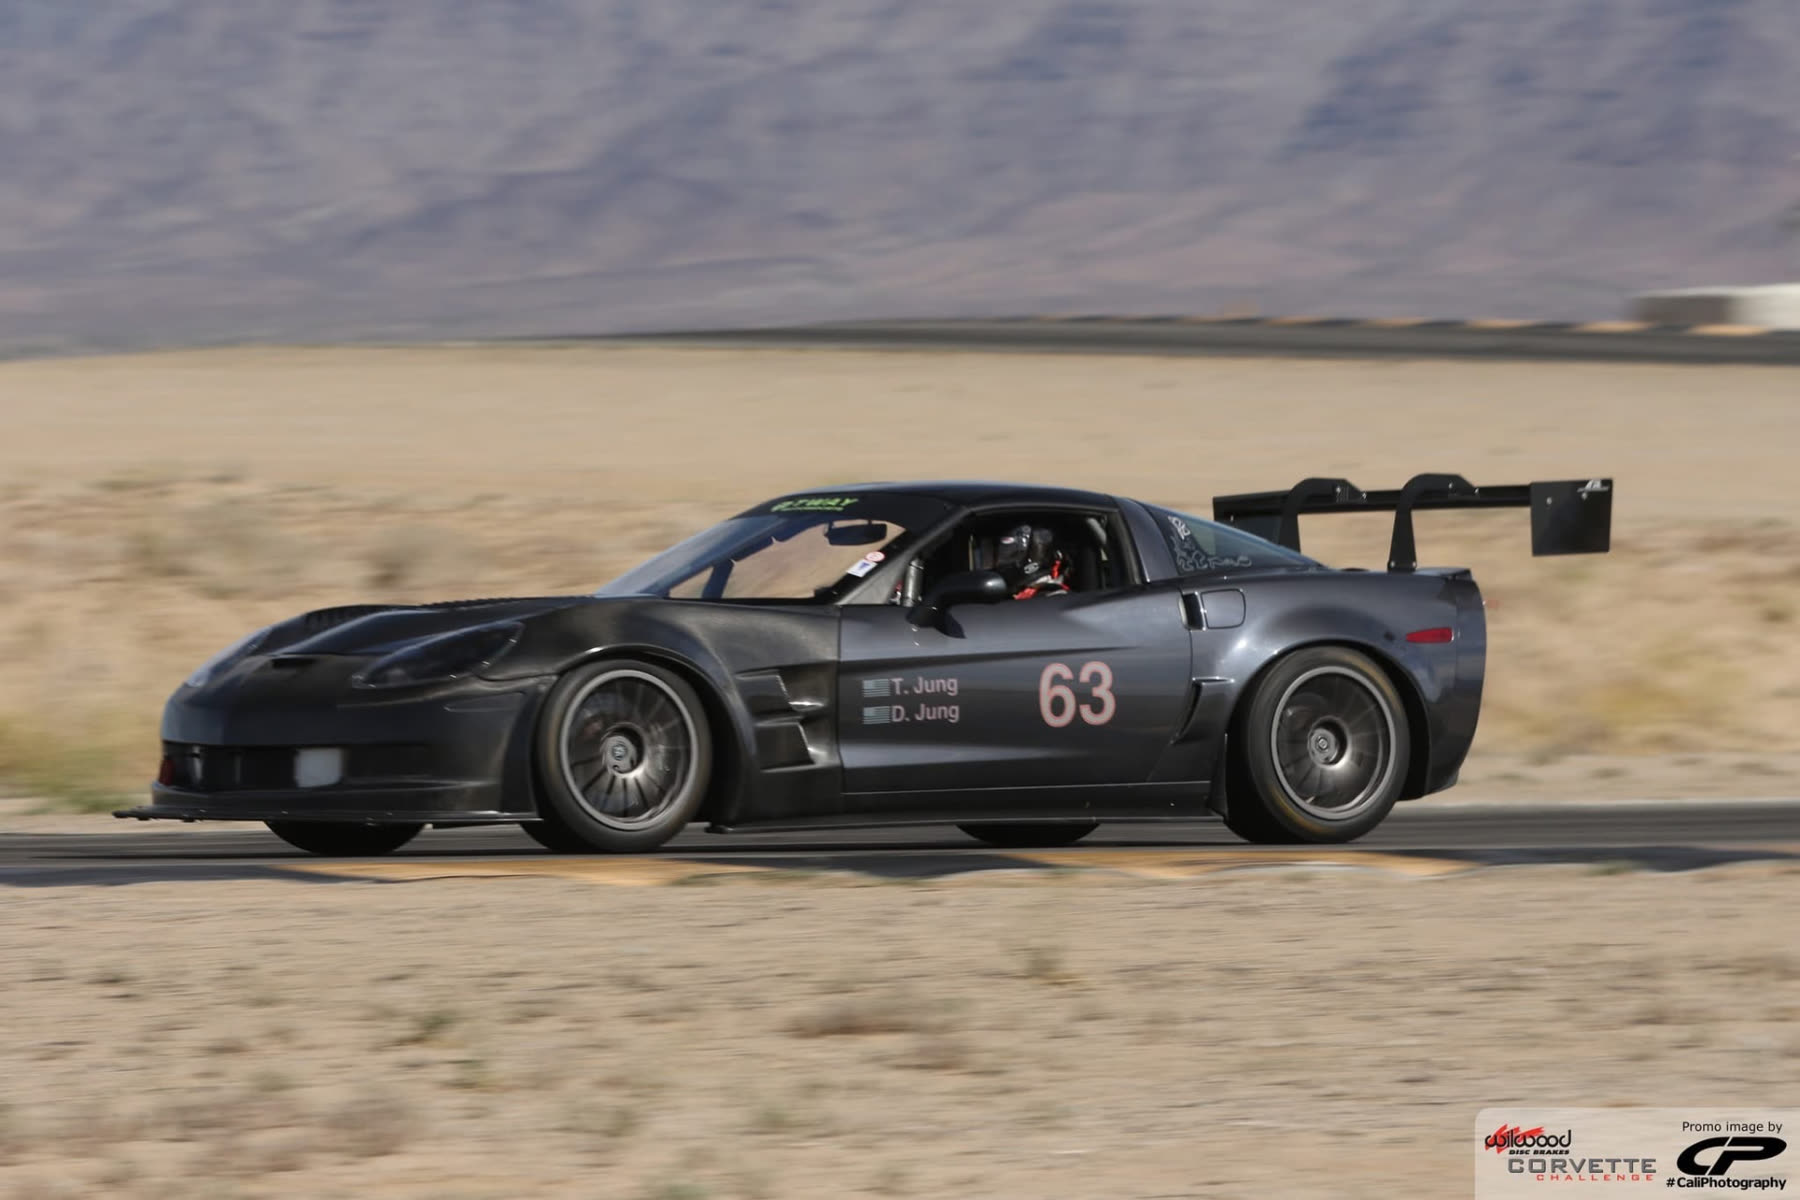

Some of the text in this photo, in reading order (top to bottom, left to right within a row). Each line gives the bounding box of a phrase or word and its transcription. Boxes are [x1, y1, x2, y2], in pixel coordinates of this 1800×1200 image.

[891, 676, 958, 696] T. Jung
[1039, 661, 1116, 728] 63
[891, 704, 960, 722] D. Jung
